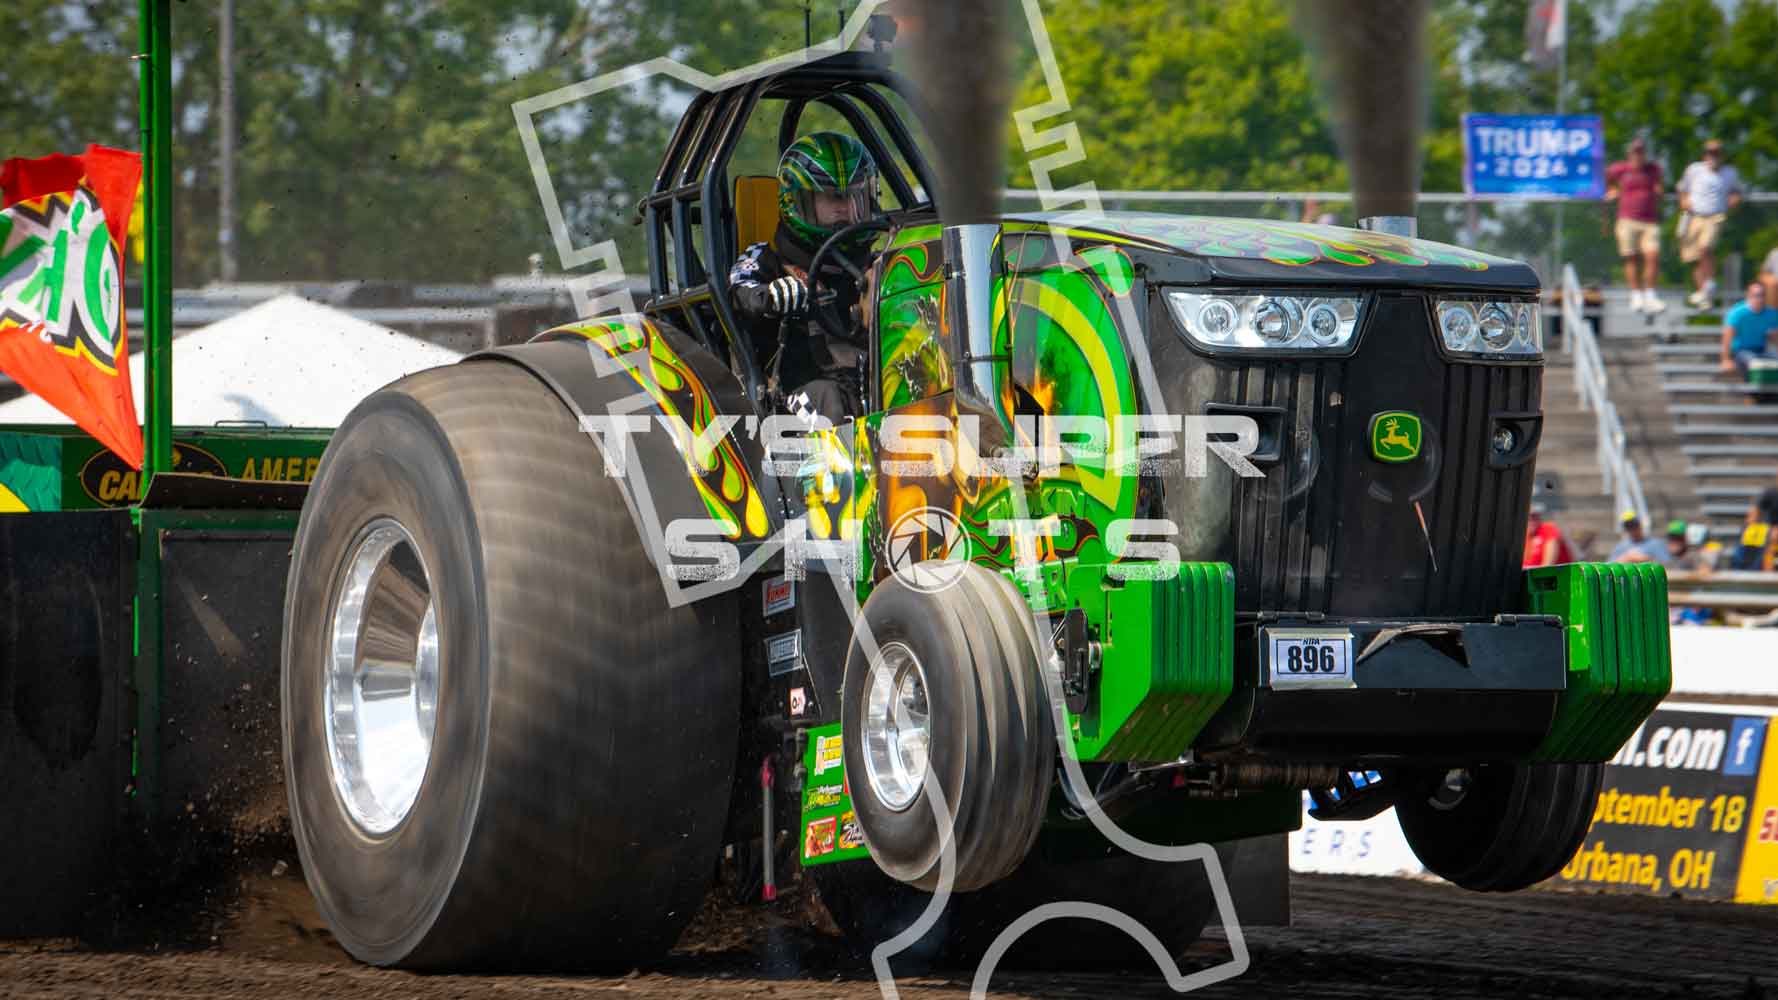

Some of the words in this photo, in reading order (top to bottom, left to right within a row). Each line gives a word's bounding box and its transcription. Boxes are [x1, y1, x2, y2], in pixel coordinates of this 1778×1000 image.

[1475, 127, 1591, 157] TRUMP
[1494, 156, 1568, 179] 2024
[1288, 645, 1335, 672] 896
[1710, 794, 1747, 833] 18
[1669, 847, 1716, 889] OH
